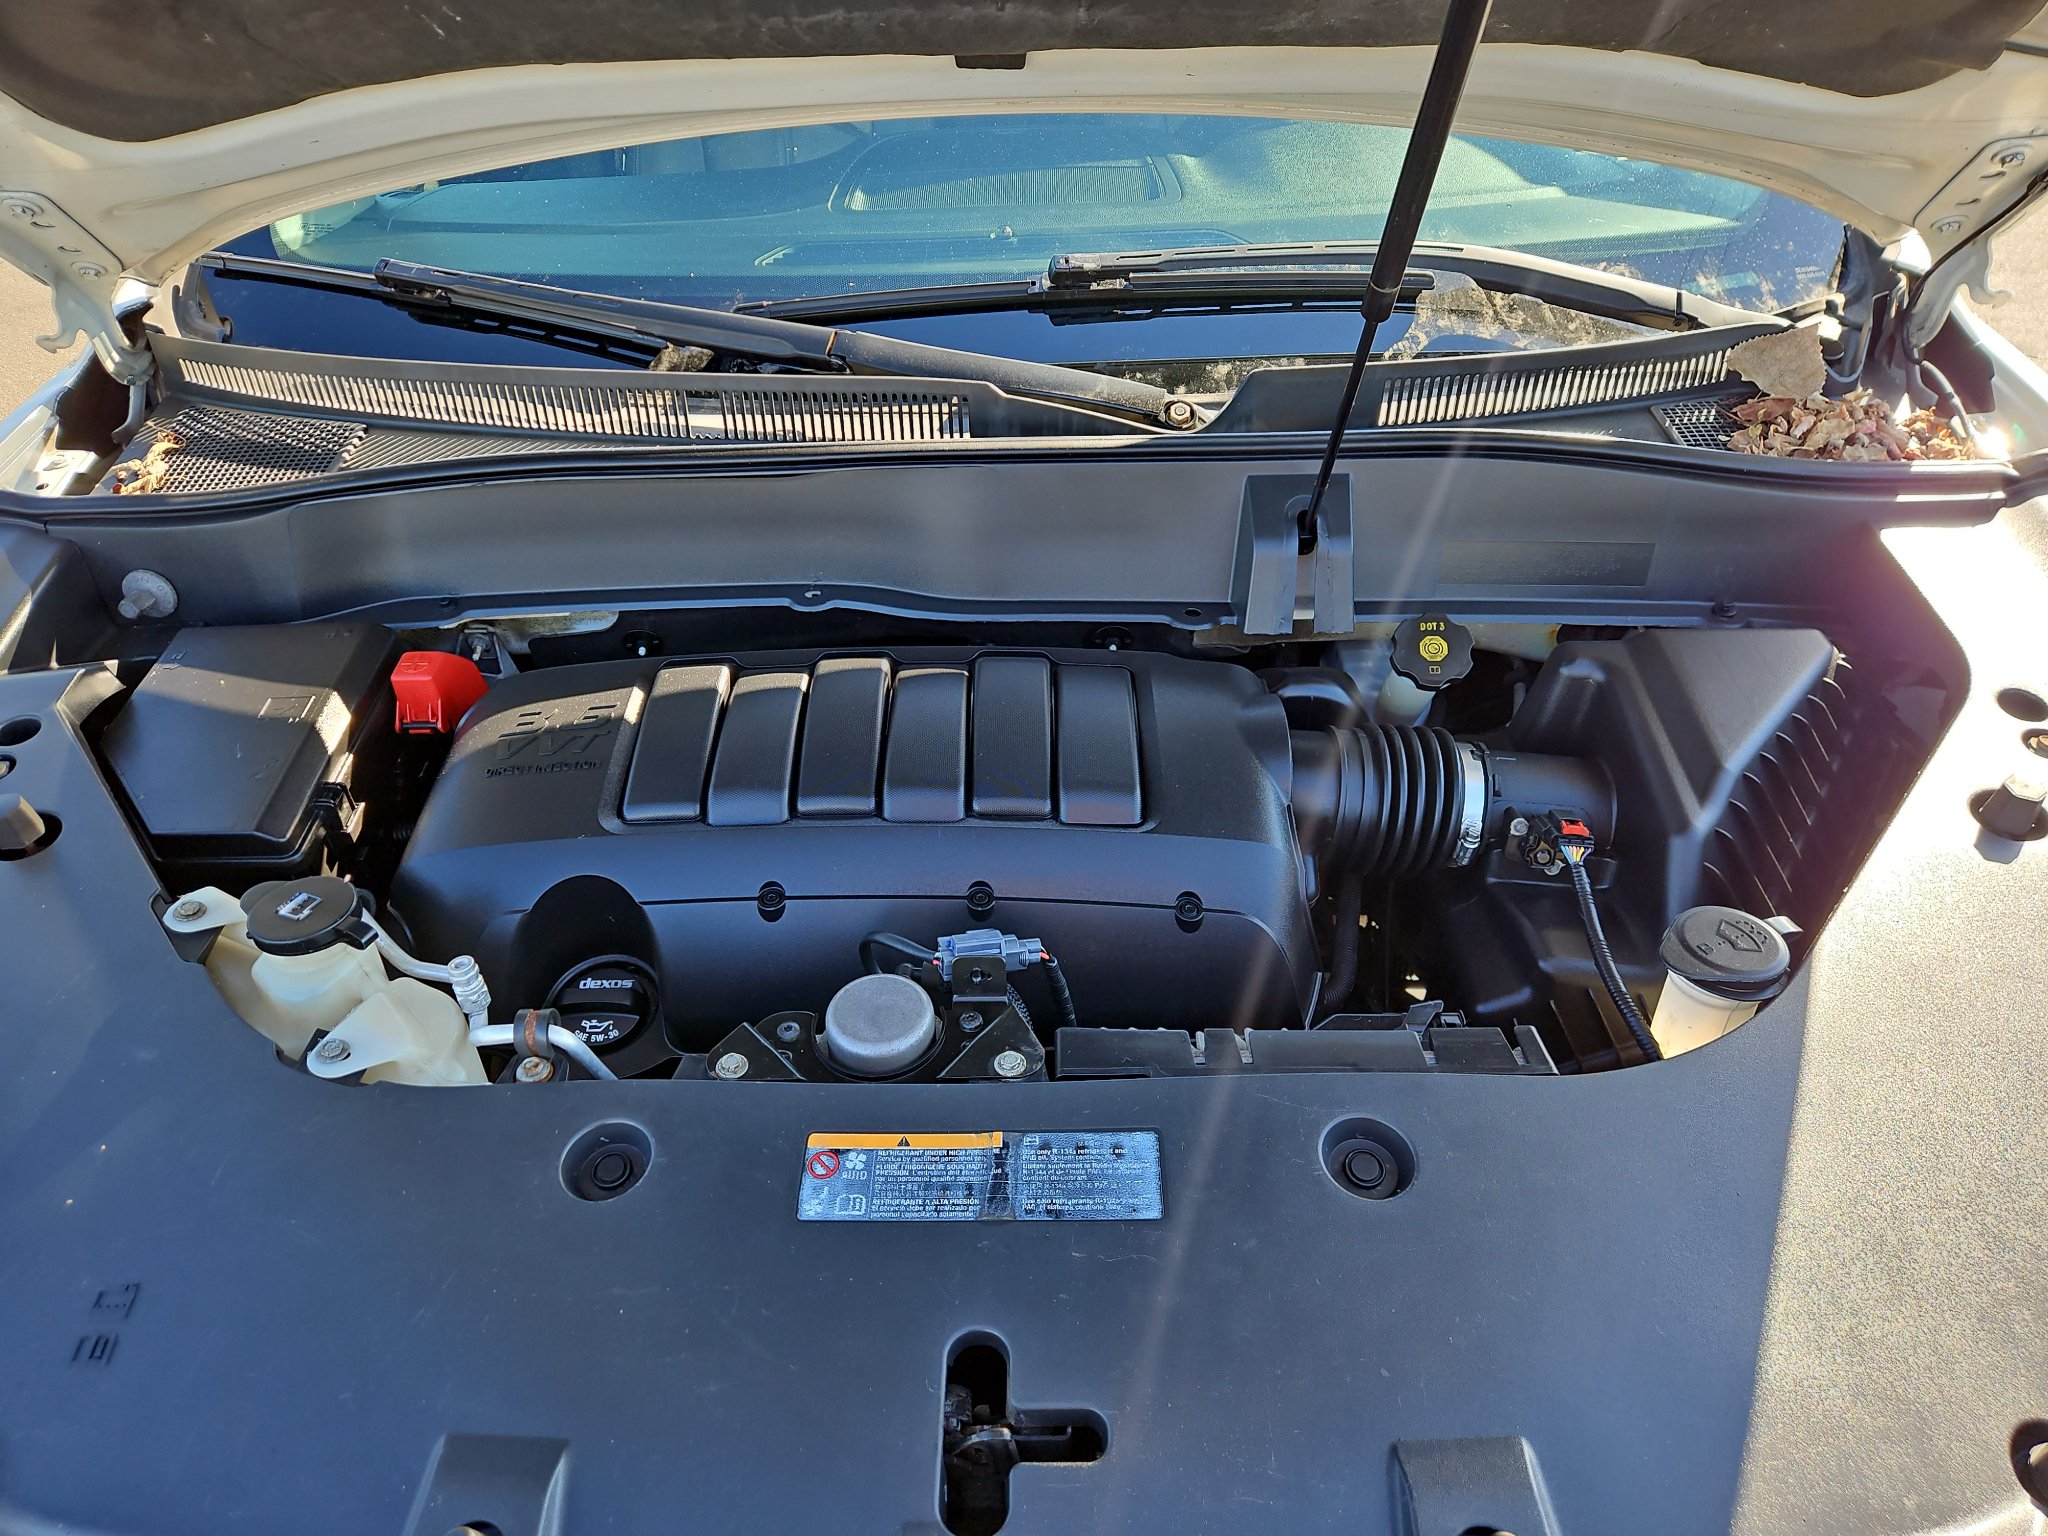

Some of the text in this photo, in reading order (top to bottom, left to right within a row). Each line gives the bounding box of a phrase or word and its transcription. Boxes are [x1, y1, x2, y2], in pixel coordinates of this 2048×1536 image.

[1420, 622, 1446, 631] DOT 3
[496, 729, 612, 760] VVT
[579, 977, 636, 990] dexos
[590, 1029, 620, 1043] 5W-30
[949, 1197, 980, 1205] PRESIÓN
